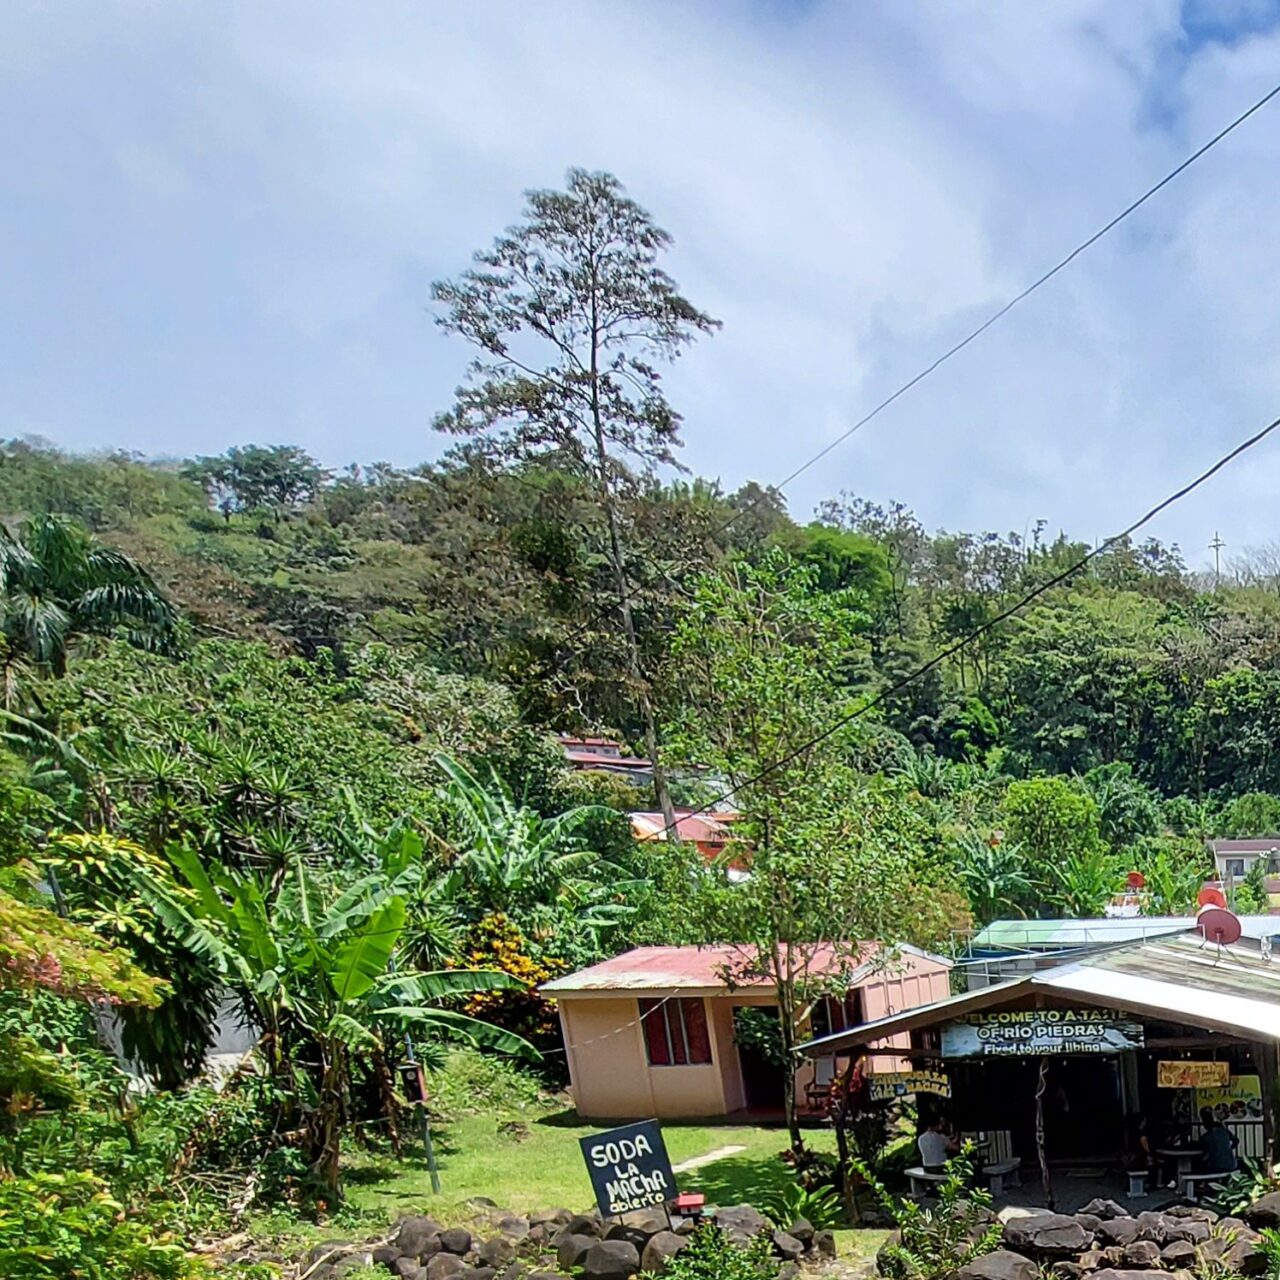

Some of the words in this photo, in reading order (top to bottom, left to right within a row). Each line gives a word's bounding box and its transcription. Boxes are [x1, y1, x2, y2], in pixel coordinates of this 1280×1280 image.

[952, 1011, 1036, 1024] WELCOME
[1039, 1010, 1059, 1022] TO
[1065, 1010, 1076, 1021] A
[1081, 1008, 1128, 1021] TASTE
[979, 1028, 1001, 1038] OF
[984, 1043, 1016, 1054] Fixed
[1020, 1044, 1033, 1053] to
[1035, 1044, 1063, 1055] your
[591, 1134, 653, 1167] SODA
[614, 1163, 639, 1179] LA
[609, 1192, 665, 1213] abierto
